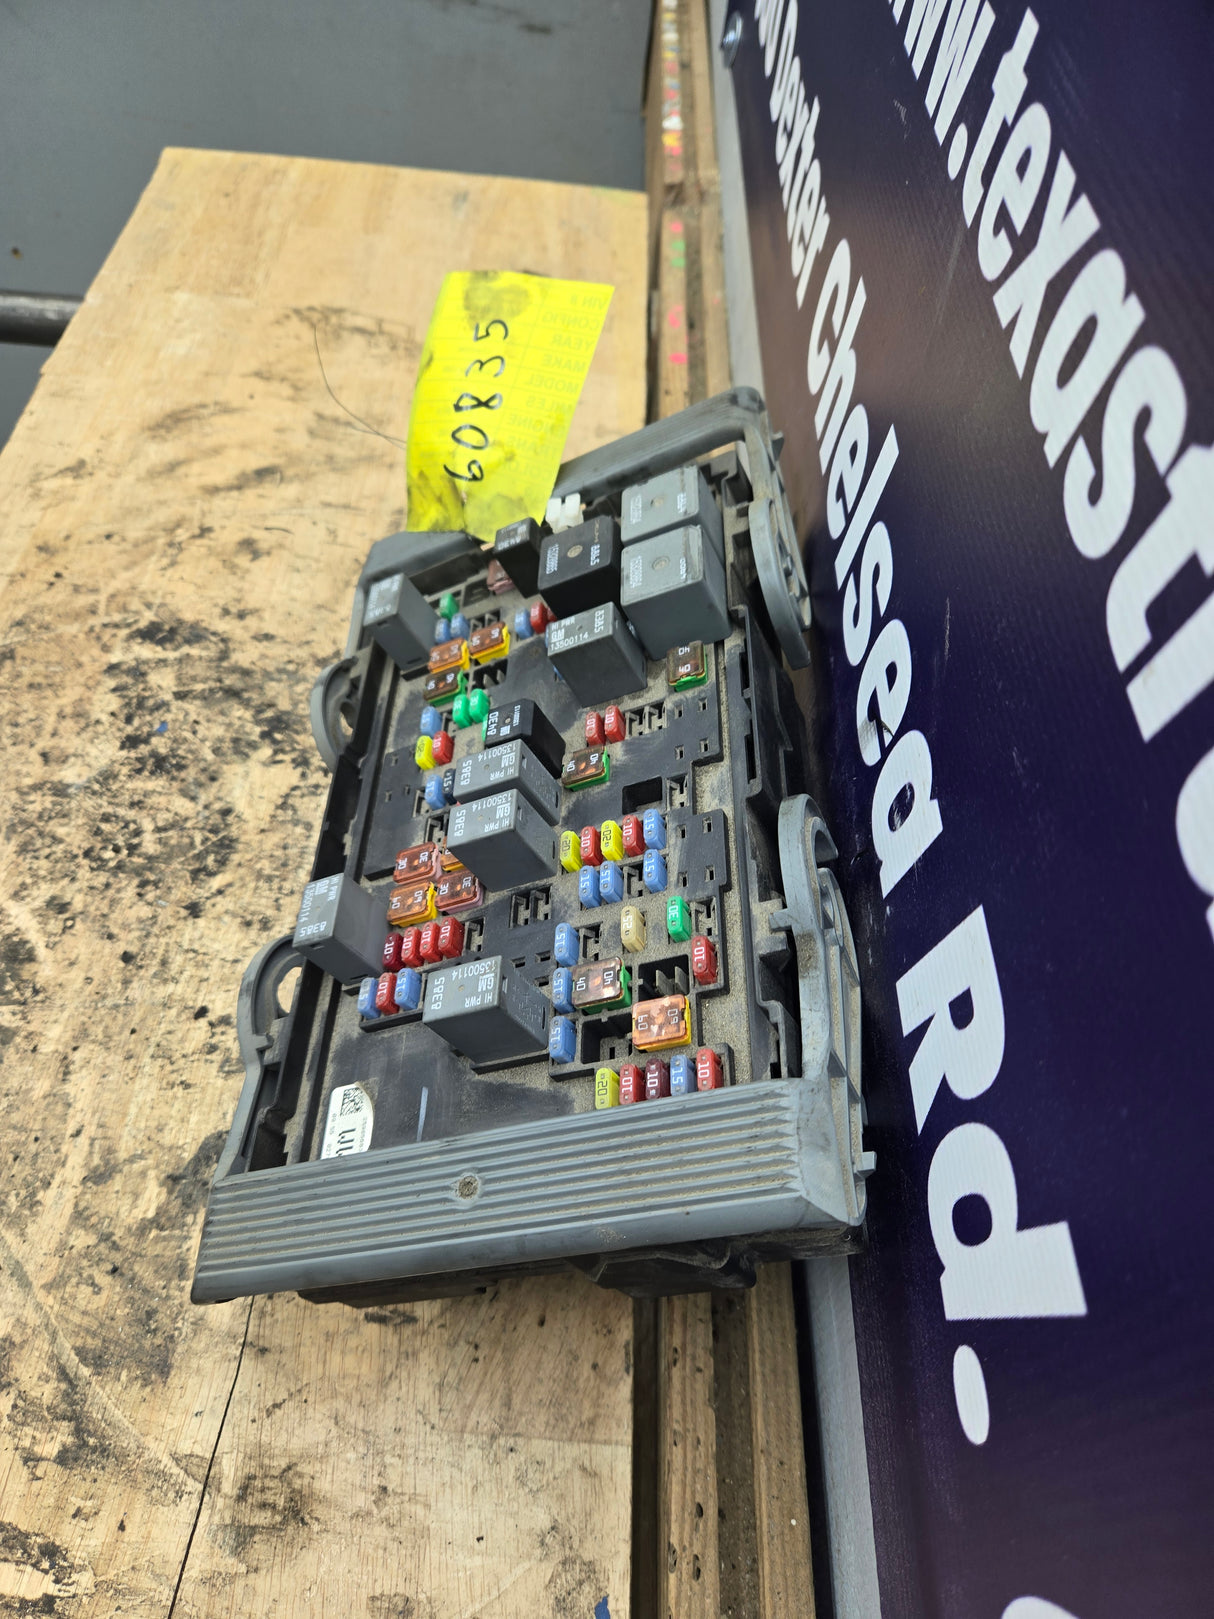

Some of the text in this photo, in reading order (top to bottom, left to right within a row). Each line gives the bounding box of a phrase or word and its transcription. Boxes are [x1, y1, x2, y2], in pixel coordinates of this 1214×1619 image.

[443, 319, 509, 482] 60835
[550, 631, 589, 651] 13500114
[551, 629, 565, 642] GM
[678, 663, 691, 673] 40
[477, 743, 516, 762] 13500114
[501, 752, 516, 768] GM
[489, 769, 505, 781] PWR
[472, 792, 512, 813] 13500114
[496, 803, 511, 819] GM
[484, 821, 501, 833] PWR
[622, 822, 633, 836] 10
[645, 816, 655, 830] 15
[580, 835, 591, 848] 10
[807, 238, 943, 899] Chelsea
[896, 905, 1088, 1446] Rd.
[645, 858, 655, 872] 15
[580, 874, 590, 888] 15
[600, 869, 611, 883] 15
[668, 904, 679, 920] 30
[622, 914, 633, 930] 25
[420, 930, 432, 944] 10
[440, 925, 451, 939] 10
[555, 931, 566, 947] 15
[383, 941, 394, 955] 10
[403, 936, 413, 950] 10
[694, 946, 705, 962] 10
[451, 959, 497, 982] 13500114
[603, 970, 614, 986] 40
[377, 981, 389, 996] 10
[396, 977, 407, 992] 15
[477, 972, 495, 993] GM
[553, 978, 564, 993] 15
[576, 976, 586, 992] 40
[431, 976, 445, 1010] 8385
[464, 992, 493, 1009] HI PWR
[638, 1013, 649, 1031] 60
[668, 1008, 678, 1025] 60
[550, 1026, 562, 1042] 15
[672, 1068, 684, 1085] 15
[698, 1061, 710, 1078] 10
[597, 1079, 608, 1096] 20
[622, 1075, 633, 1093] 10
[647, 1071, 659, 1088] 10
